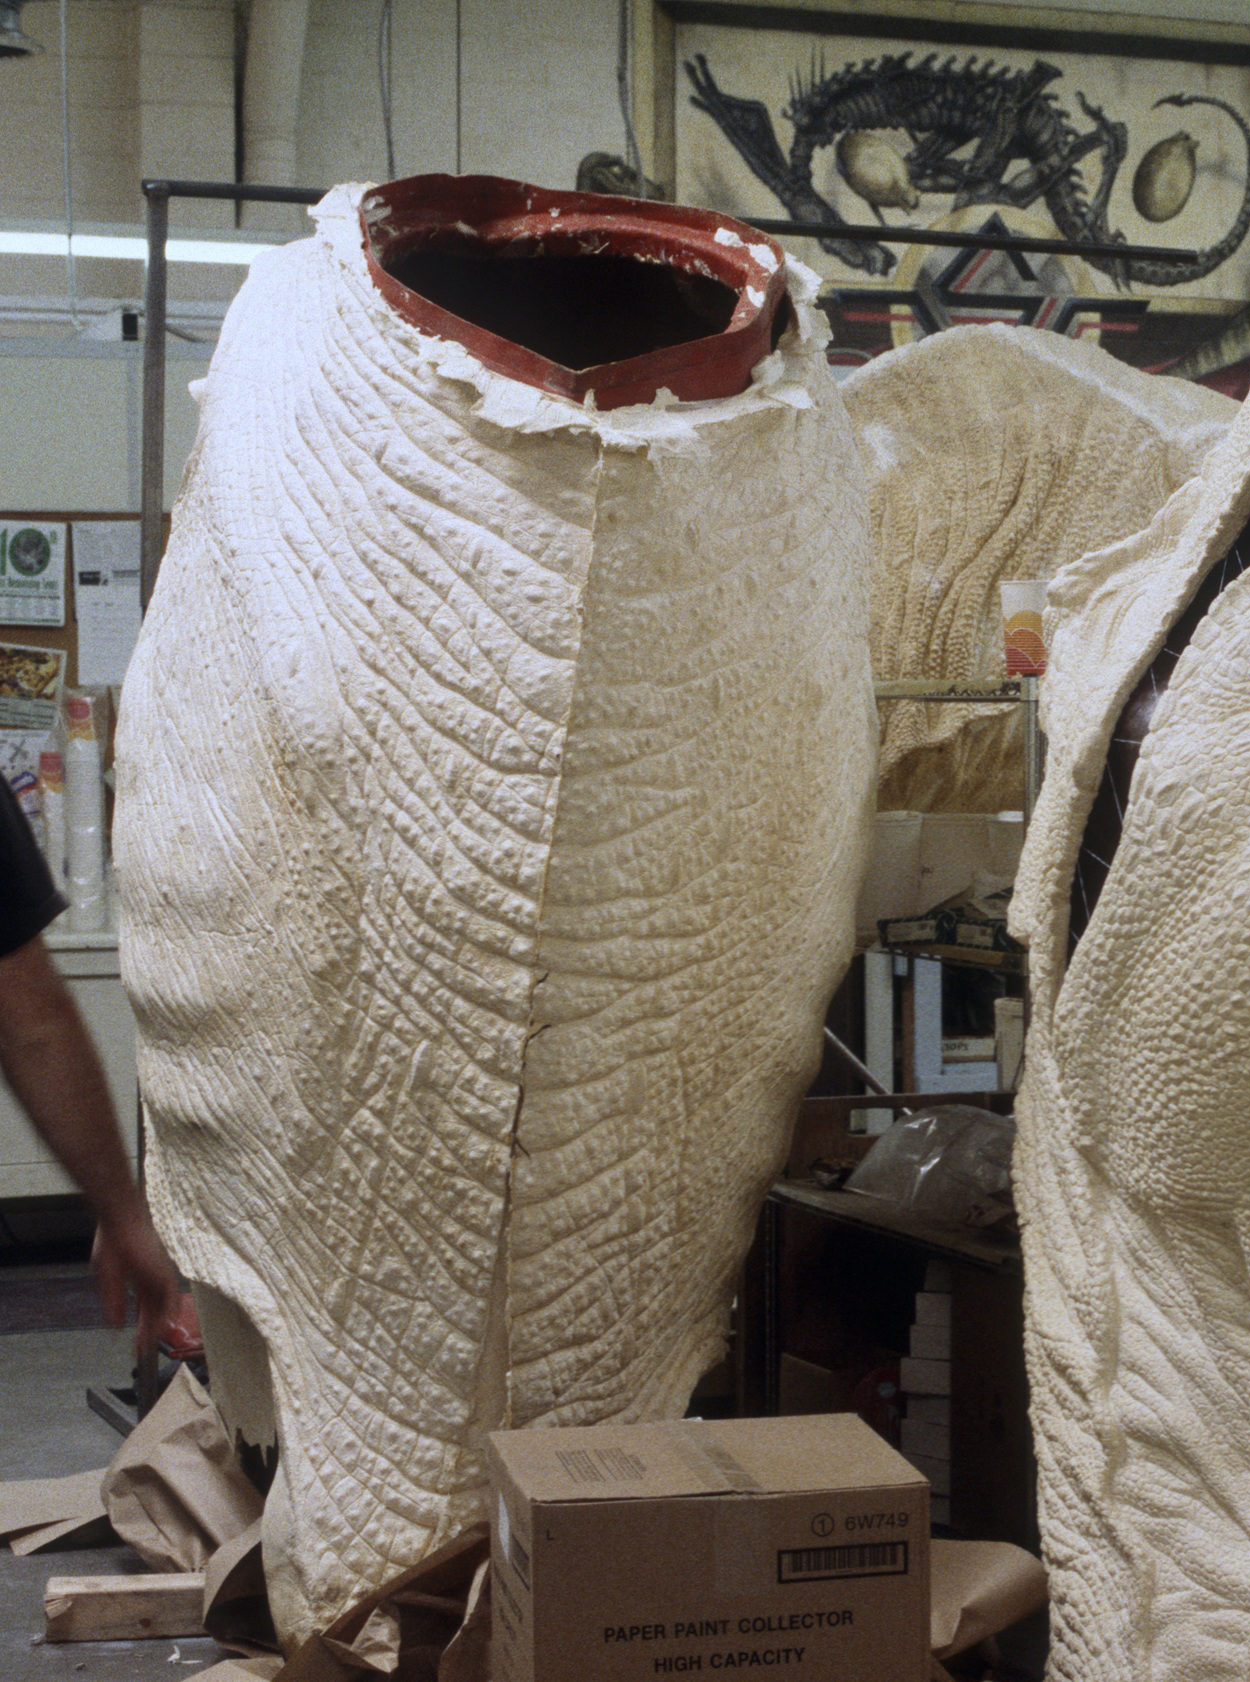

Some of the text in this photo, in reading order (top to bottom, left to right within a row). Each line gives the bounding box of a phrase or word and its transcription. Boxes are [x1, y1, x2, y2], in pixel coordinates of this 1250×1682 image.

[845, 1512, 909, 1531] 6W749
[603, 1610, 854, 1643] PAPER PAINT COLLECTOR
[654, 1647, 806, 1673] HIGH CAPACITY
